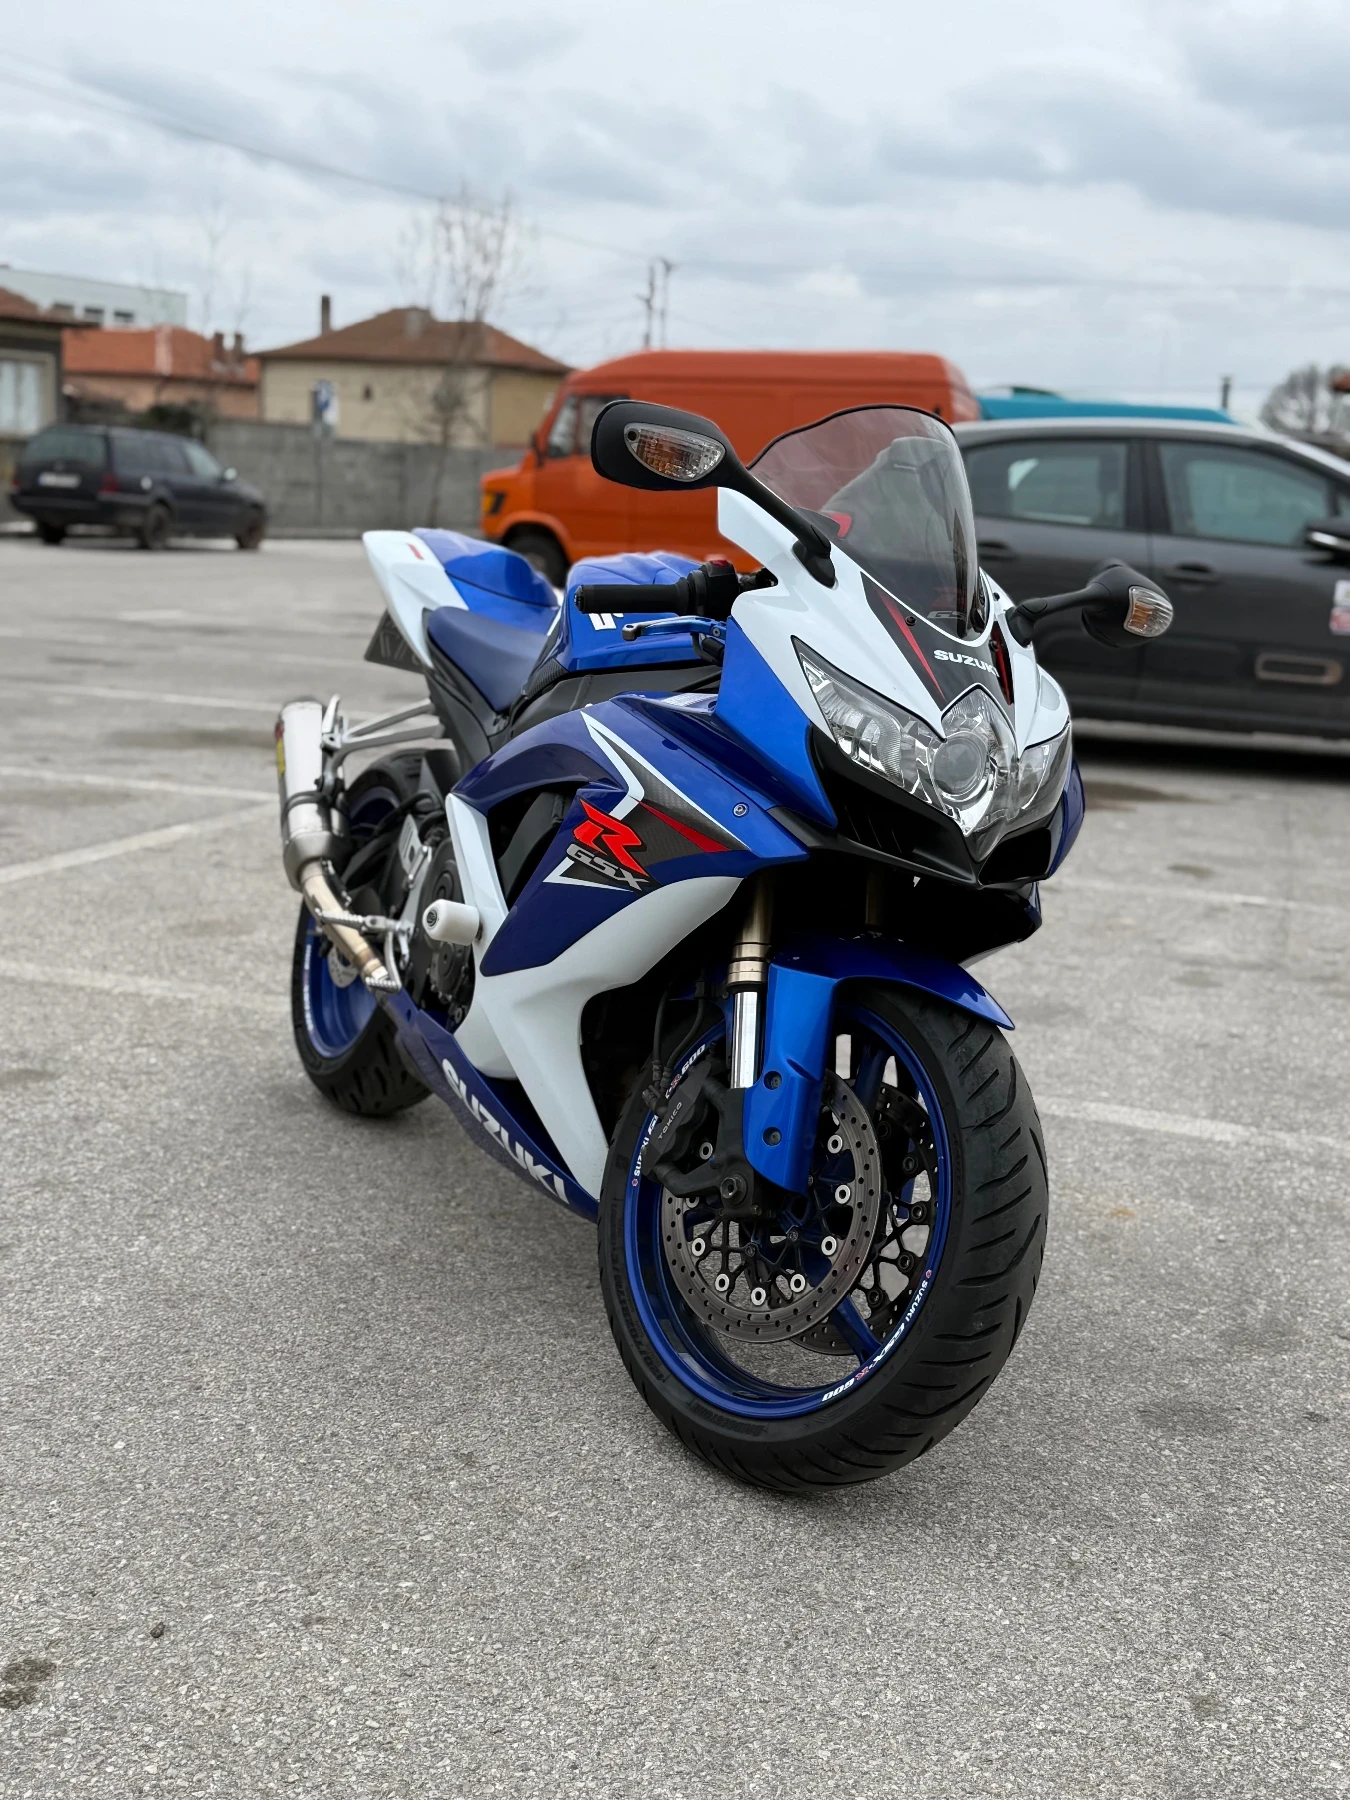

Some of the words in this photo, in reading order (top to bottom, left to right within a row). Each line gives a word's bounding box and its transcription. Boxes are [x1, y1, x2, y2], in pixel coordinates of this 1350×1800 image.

[573, 798, 650, 878] R
[566, 843, 649, 892] GSX
[681, 1043, 706, 1075] 600
[442, 1058, 571, 1205] SUZUKI
[658, 1101, 683, 1140] TOKICO
[905, 1279, 928, 1322] SUZUKI
[821, 1377, 855, 1402] 600
